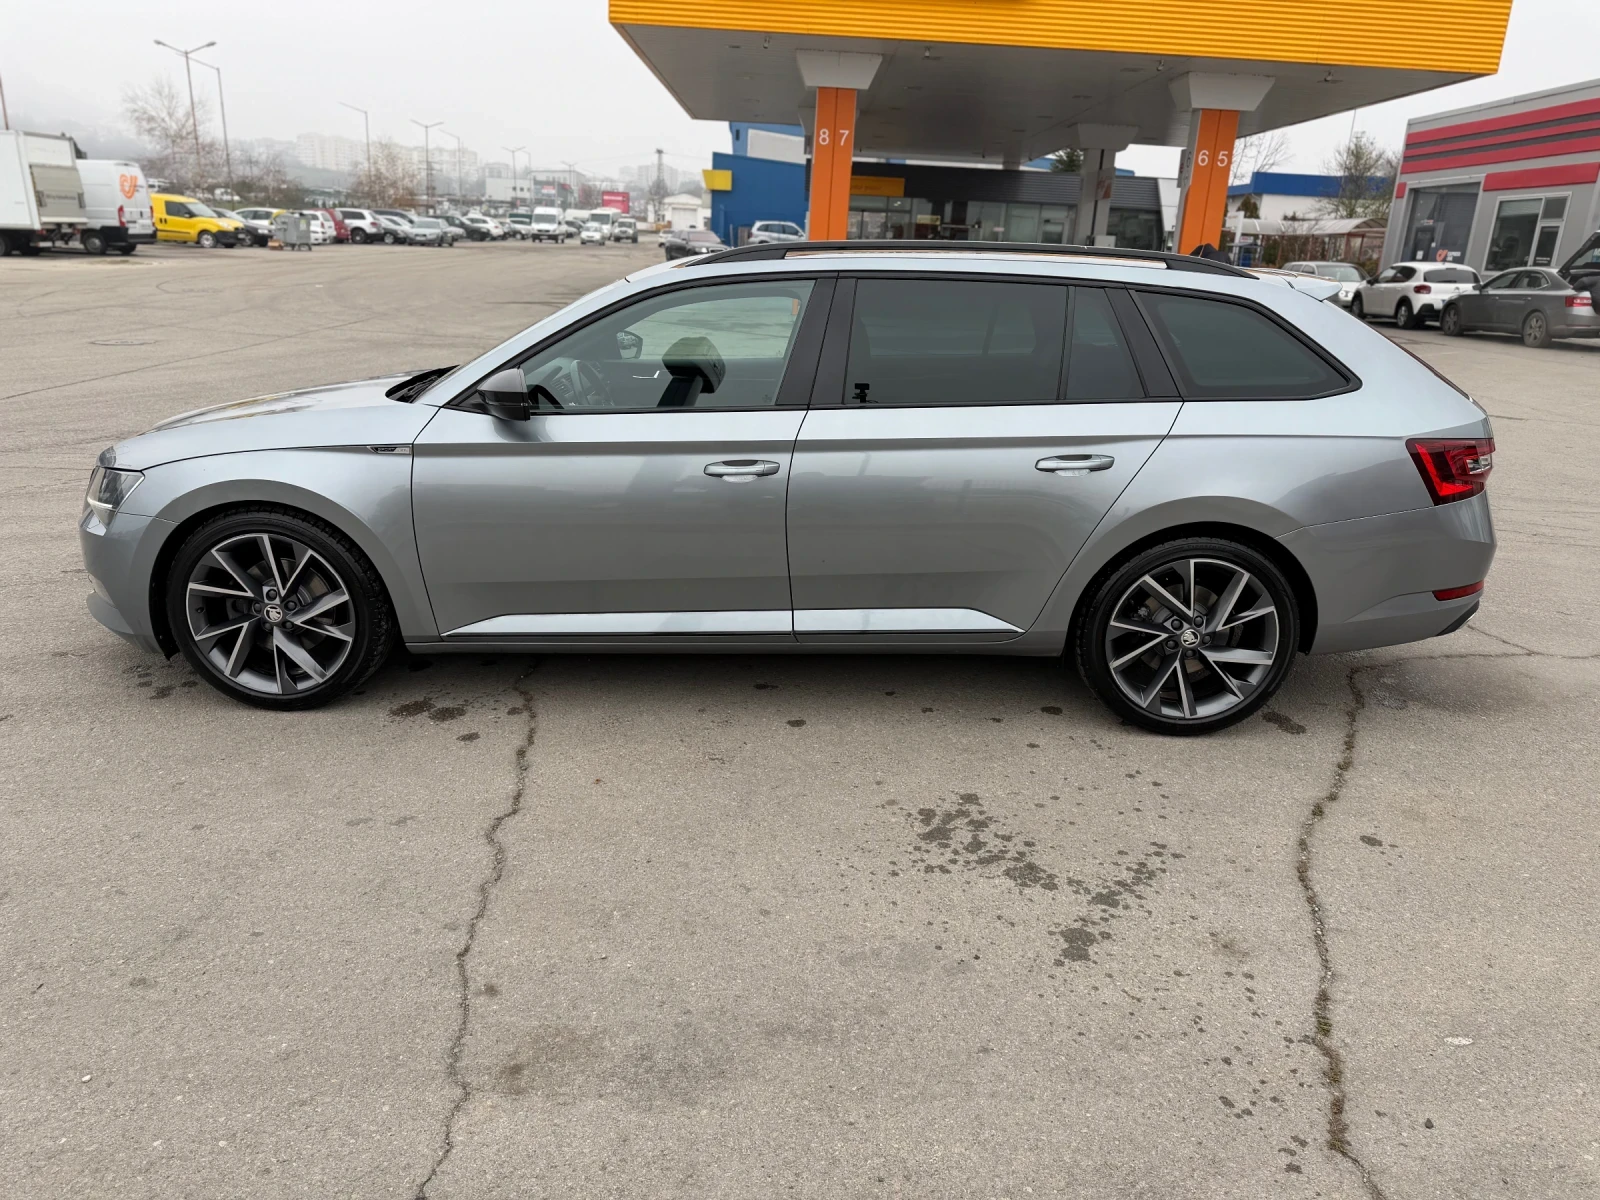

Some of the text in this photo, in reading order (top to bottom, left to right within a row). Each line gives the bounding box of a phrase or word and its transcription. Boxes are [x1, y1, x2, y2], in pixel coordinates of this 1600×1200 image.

[819, 128, 850, 147] 8 7
[1198, 149, 1209, 167] 6
[1217, 150, 1229, 167] 5
